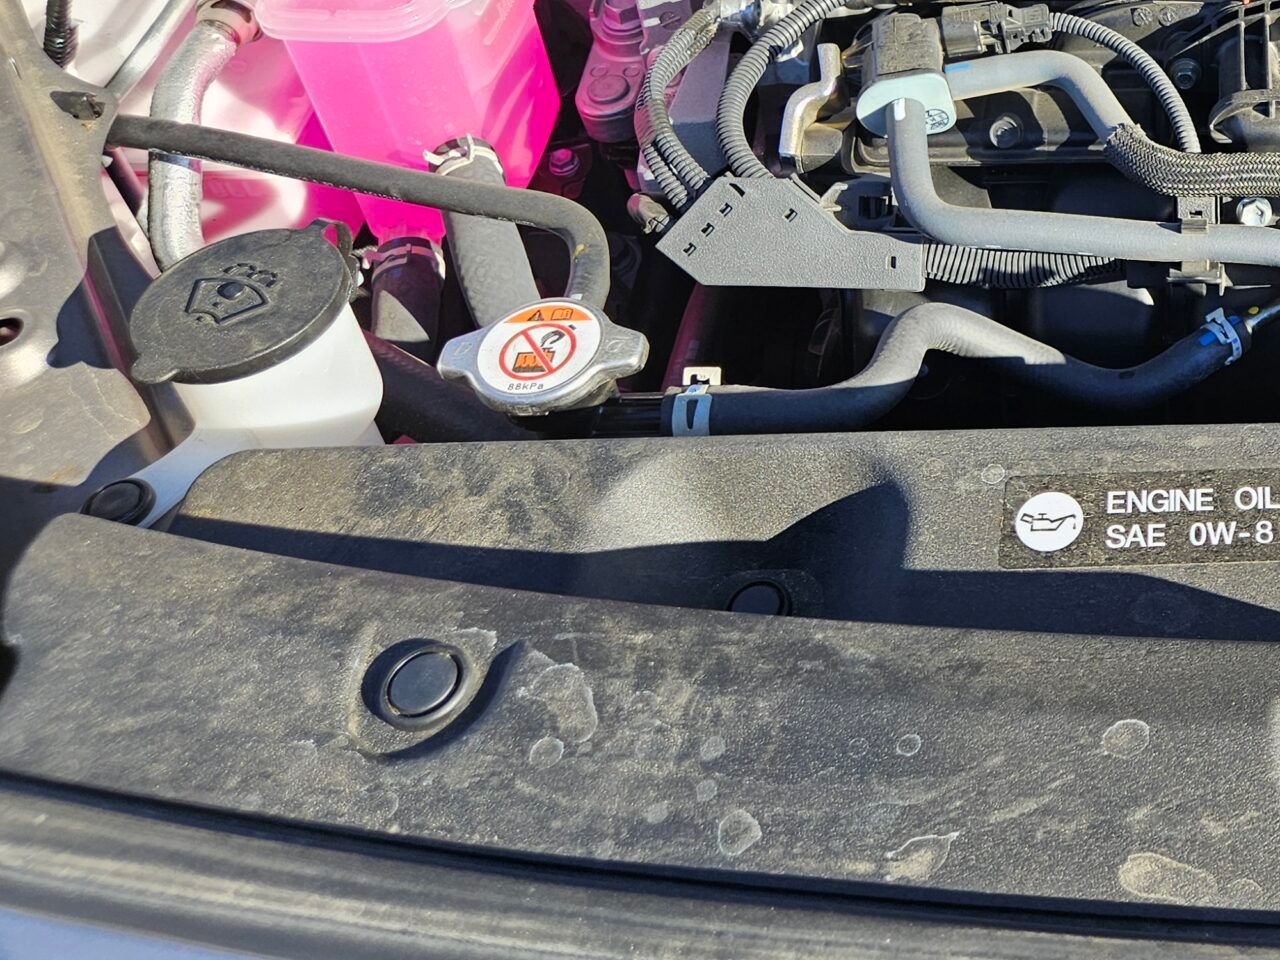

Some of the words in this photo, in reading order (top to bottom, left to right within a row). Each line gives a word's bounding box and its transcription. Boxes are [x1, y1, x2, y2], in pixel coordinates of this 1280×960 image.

[507, 382, 544, 391] 88kPa
[1106, 488, 1214, 514] ENGINE
[1105, 523, 1166, 549] SAE
[1189, 520, 1274, 547] 0W-8
